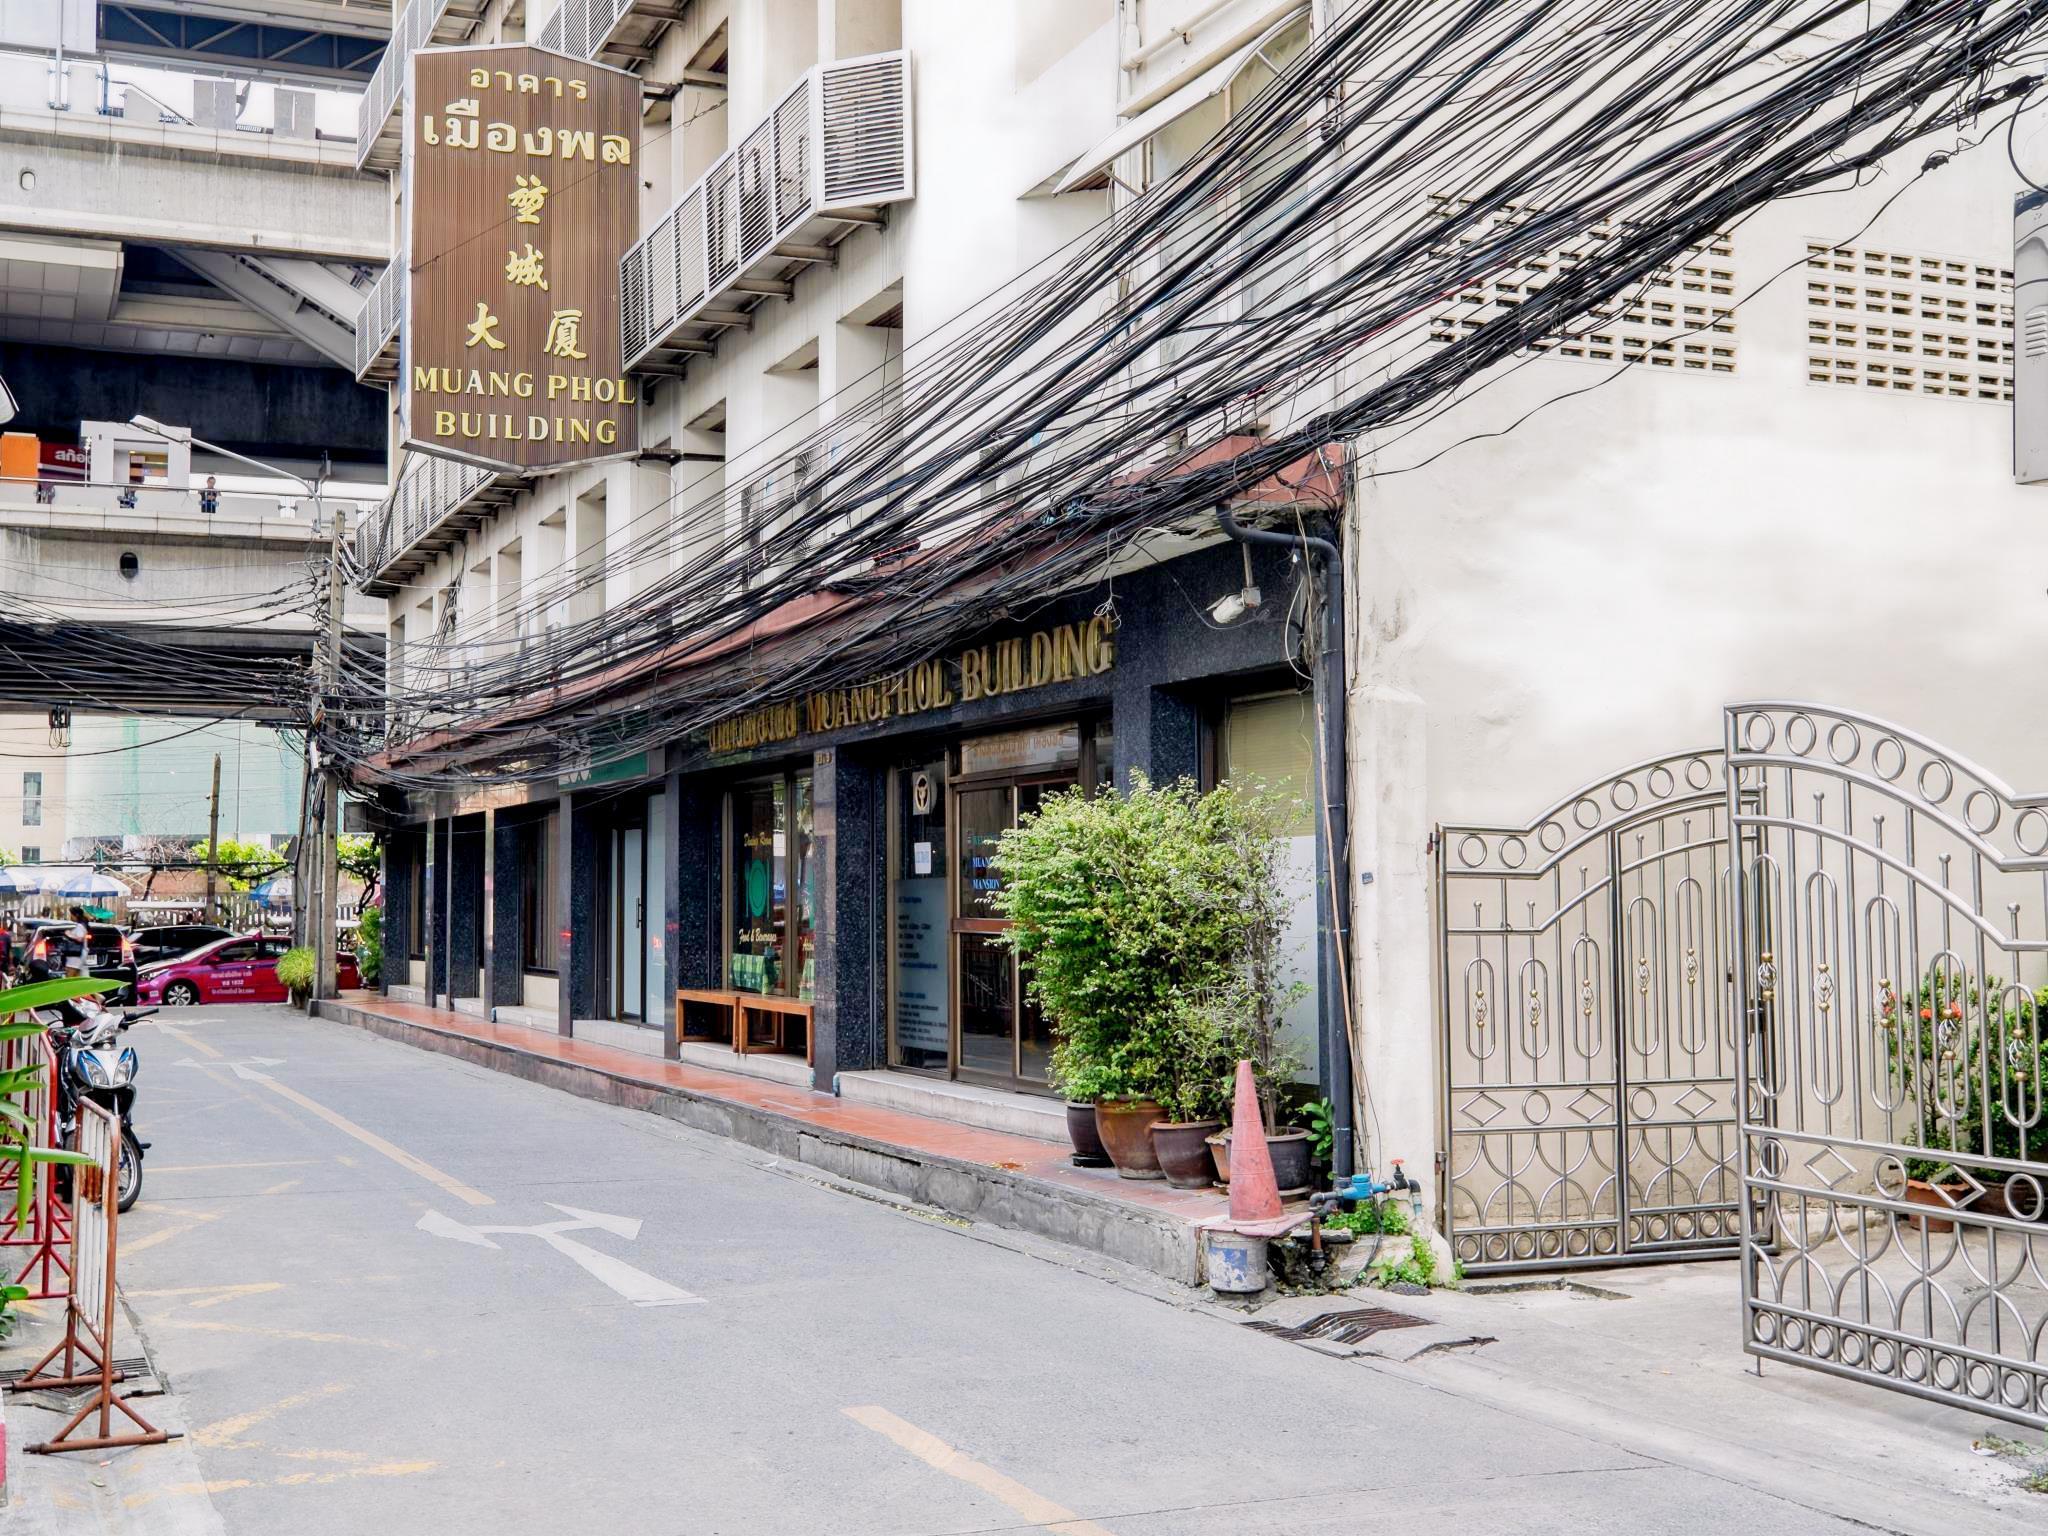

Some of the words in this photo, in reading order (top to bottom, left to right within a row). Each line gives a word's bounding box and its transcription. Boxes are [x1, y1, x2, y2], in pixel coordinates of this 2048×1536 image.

[471, 68, 587, 99] อาคาร
[424, 98, 631, 164] เมืองพล
[414, 366, 534, 397] MUANG
[547, 375, 635, 404] PHOL
[435, 411, 616, 444] BUILDING
[961, 617, 1113, 701] BUILDING
[972, 878, 1000, 890] MANSION
